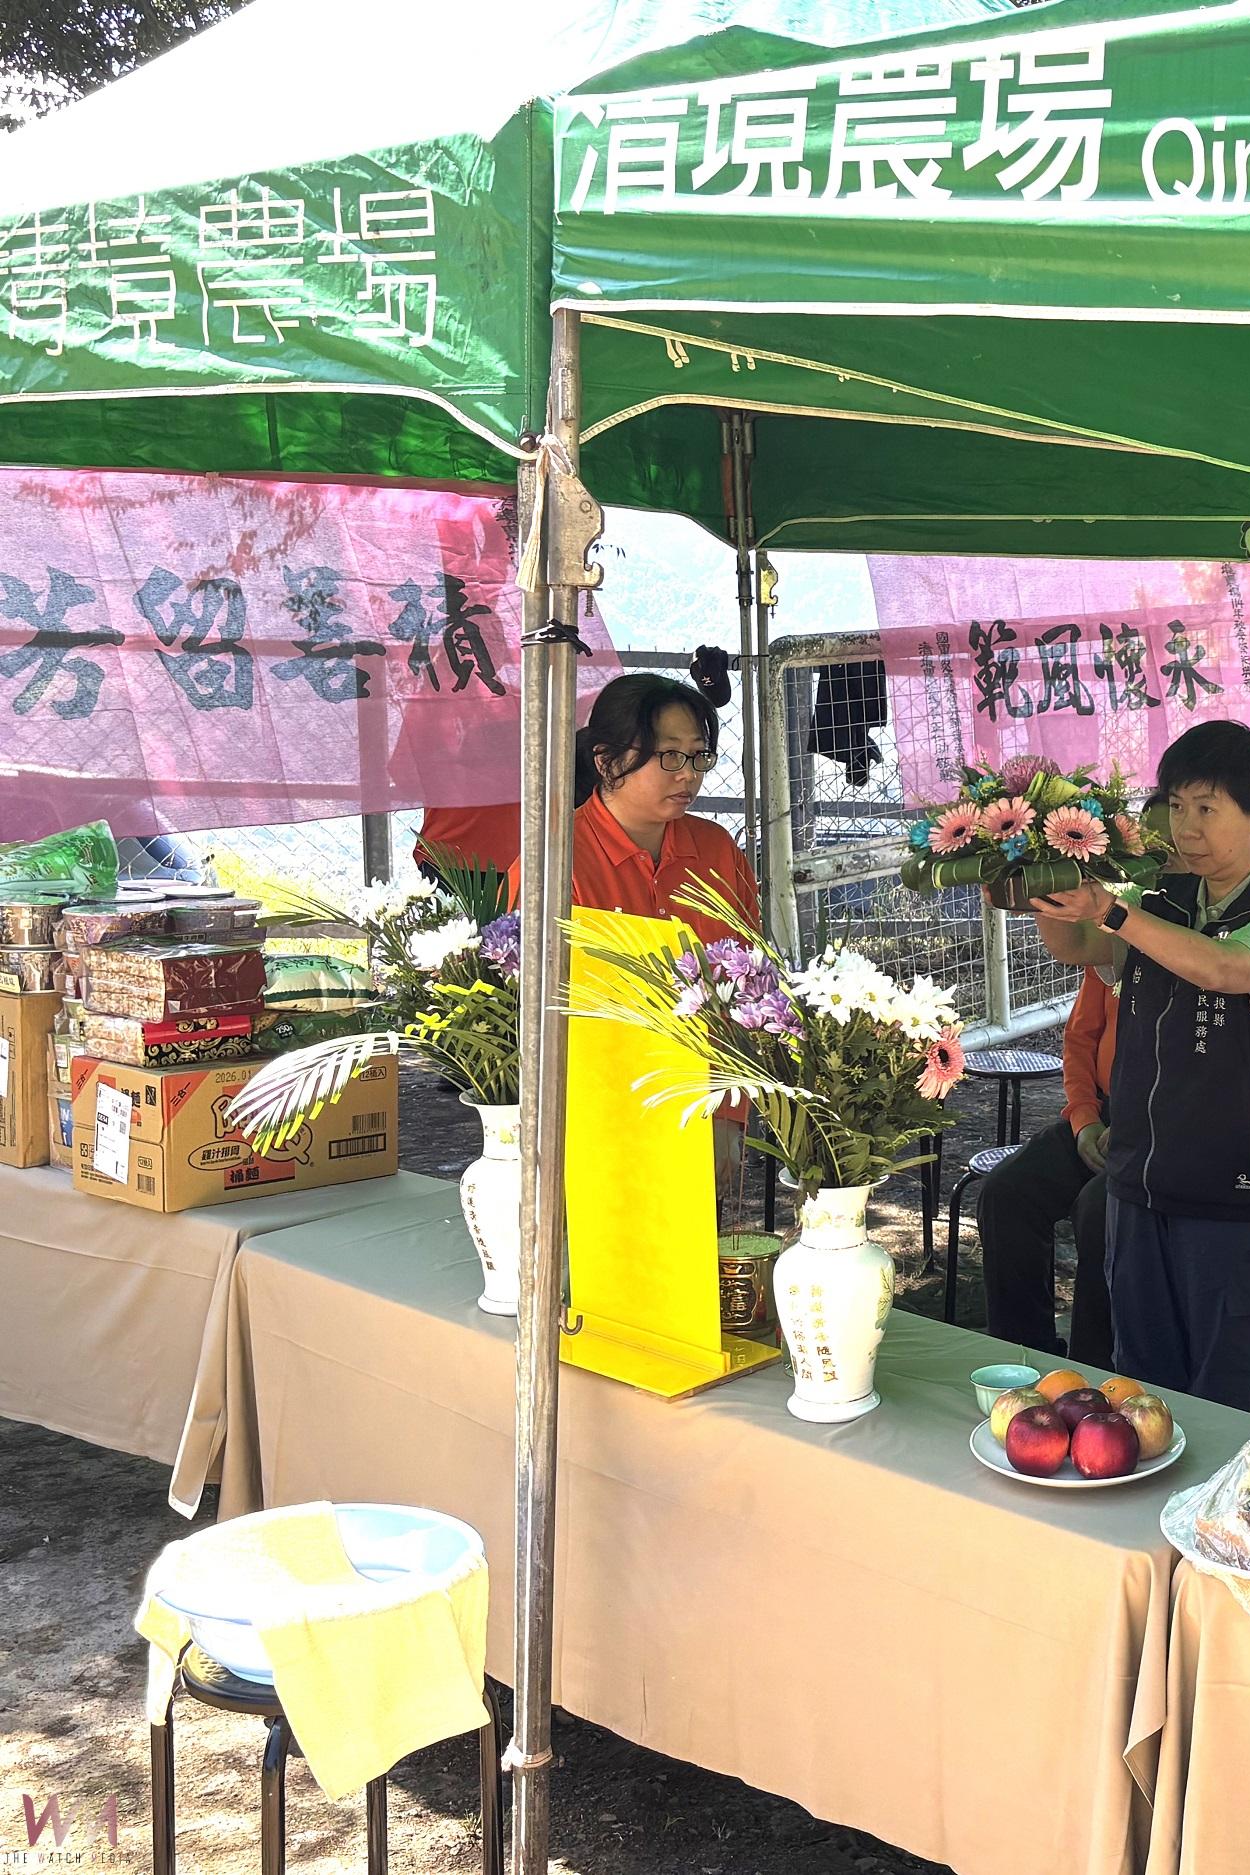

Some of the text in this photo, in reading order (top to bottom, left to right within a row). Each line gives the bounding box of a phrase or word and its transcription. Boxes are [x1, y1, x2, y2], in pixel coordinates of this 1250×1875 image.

[1194, 988, 1209, 1054] 民服務處
[170, 1082, 191, 1107] 三合一
